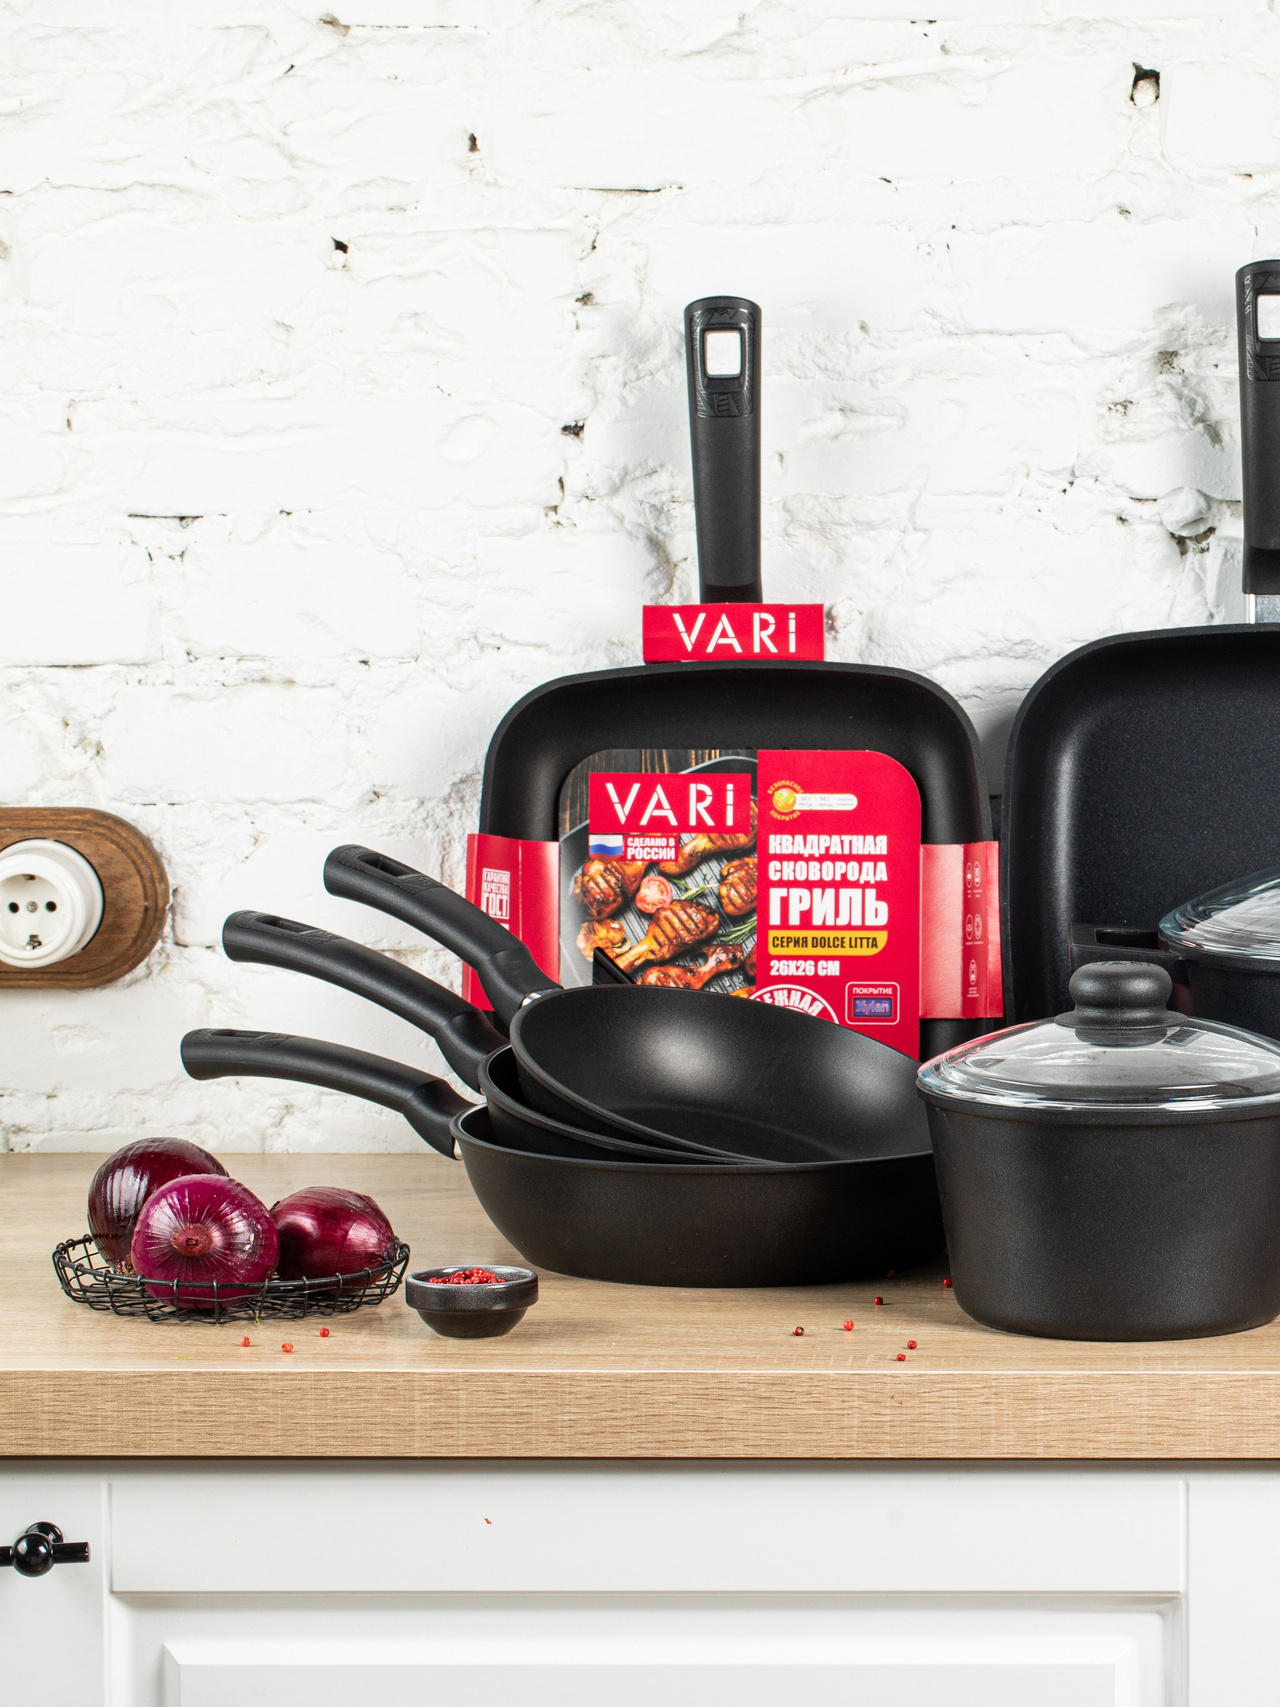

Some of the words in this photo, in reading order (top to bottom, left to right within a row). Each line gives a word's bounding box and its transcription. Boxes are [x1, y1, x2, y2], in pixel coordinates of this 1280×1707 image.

[627, 837, 667, 847] СДЕЛАНО
[669, 837, 675, 846] В
[769, 834, 888, 857] КВАДРАТНАЯ
[627, 848, 675, 860] РОССИИ
[768, 861, 888, 884] СКОВОРОДА
[483, 892, 508, 917] ГОСТ
[769, 888, 889, 926] ГРИЛЬ
[772, 936, 808, 949] СЕРИЯ
[811, 937, 846, 949] DOLCE
[849, 937, 879, 949] LITTA
[769, 960, 815, 976] 26Х26
[853, 987, 893, 995] ПОКРЫТИЕ
[757, 990, 824, 1016] ЕЖНАЯ
